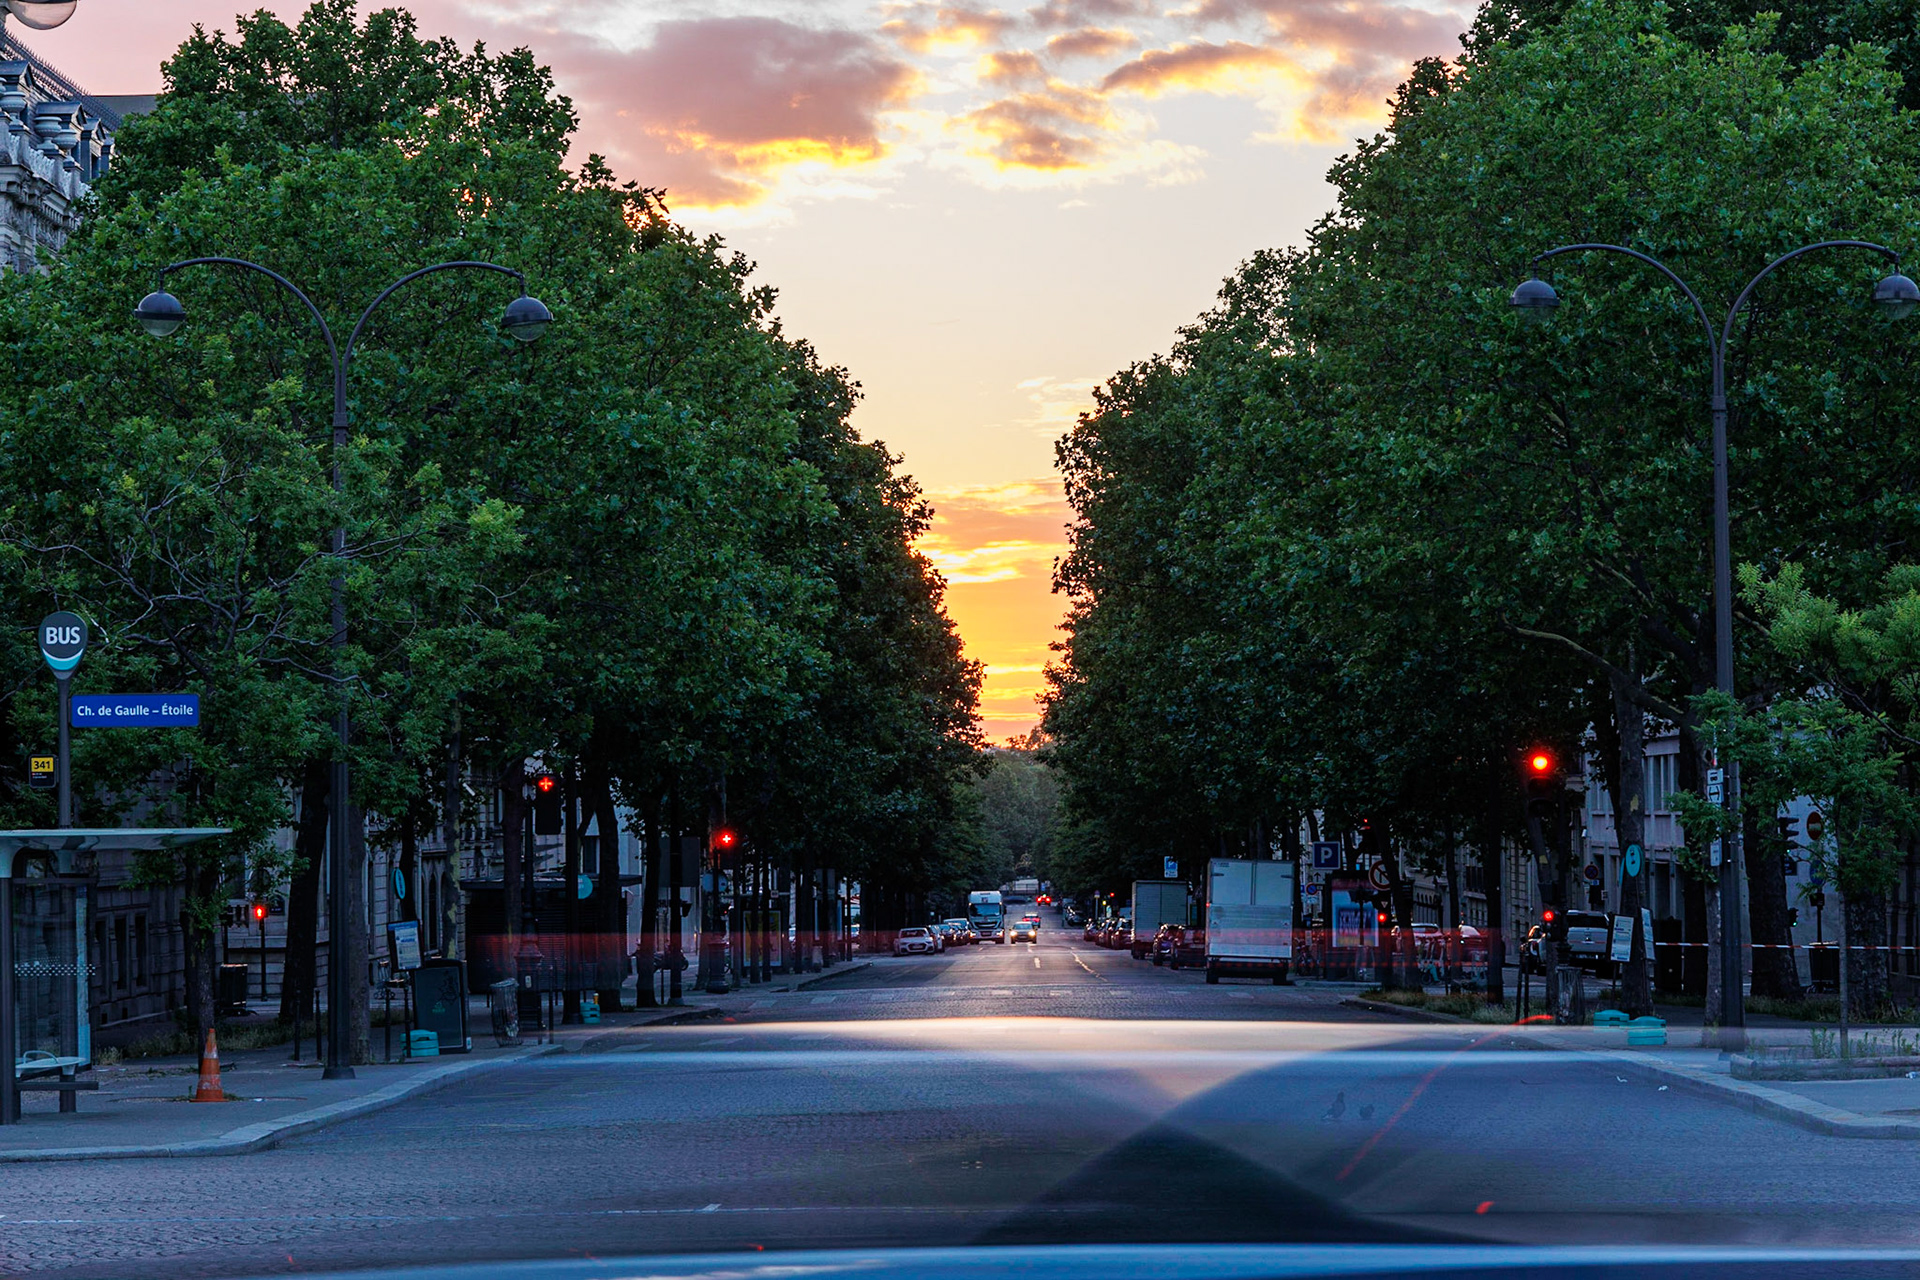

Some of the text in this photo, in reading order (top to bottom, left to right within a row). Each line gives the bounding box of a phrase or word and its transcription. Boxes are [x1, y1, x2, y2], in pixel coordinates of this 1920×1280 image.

[46, 626, 81, 645] BUS
[77, 705, 95, 716] Ch.
[98, 705, 112, 716] de
[114, 705, 150, 716] Gaulle
[161, 703, 194, 716] Étoile
[33, 760, 51, 770] 341
[1320, 846, 1333, 864] P
